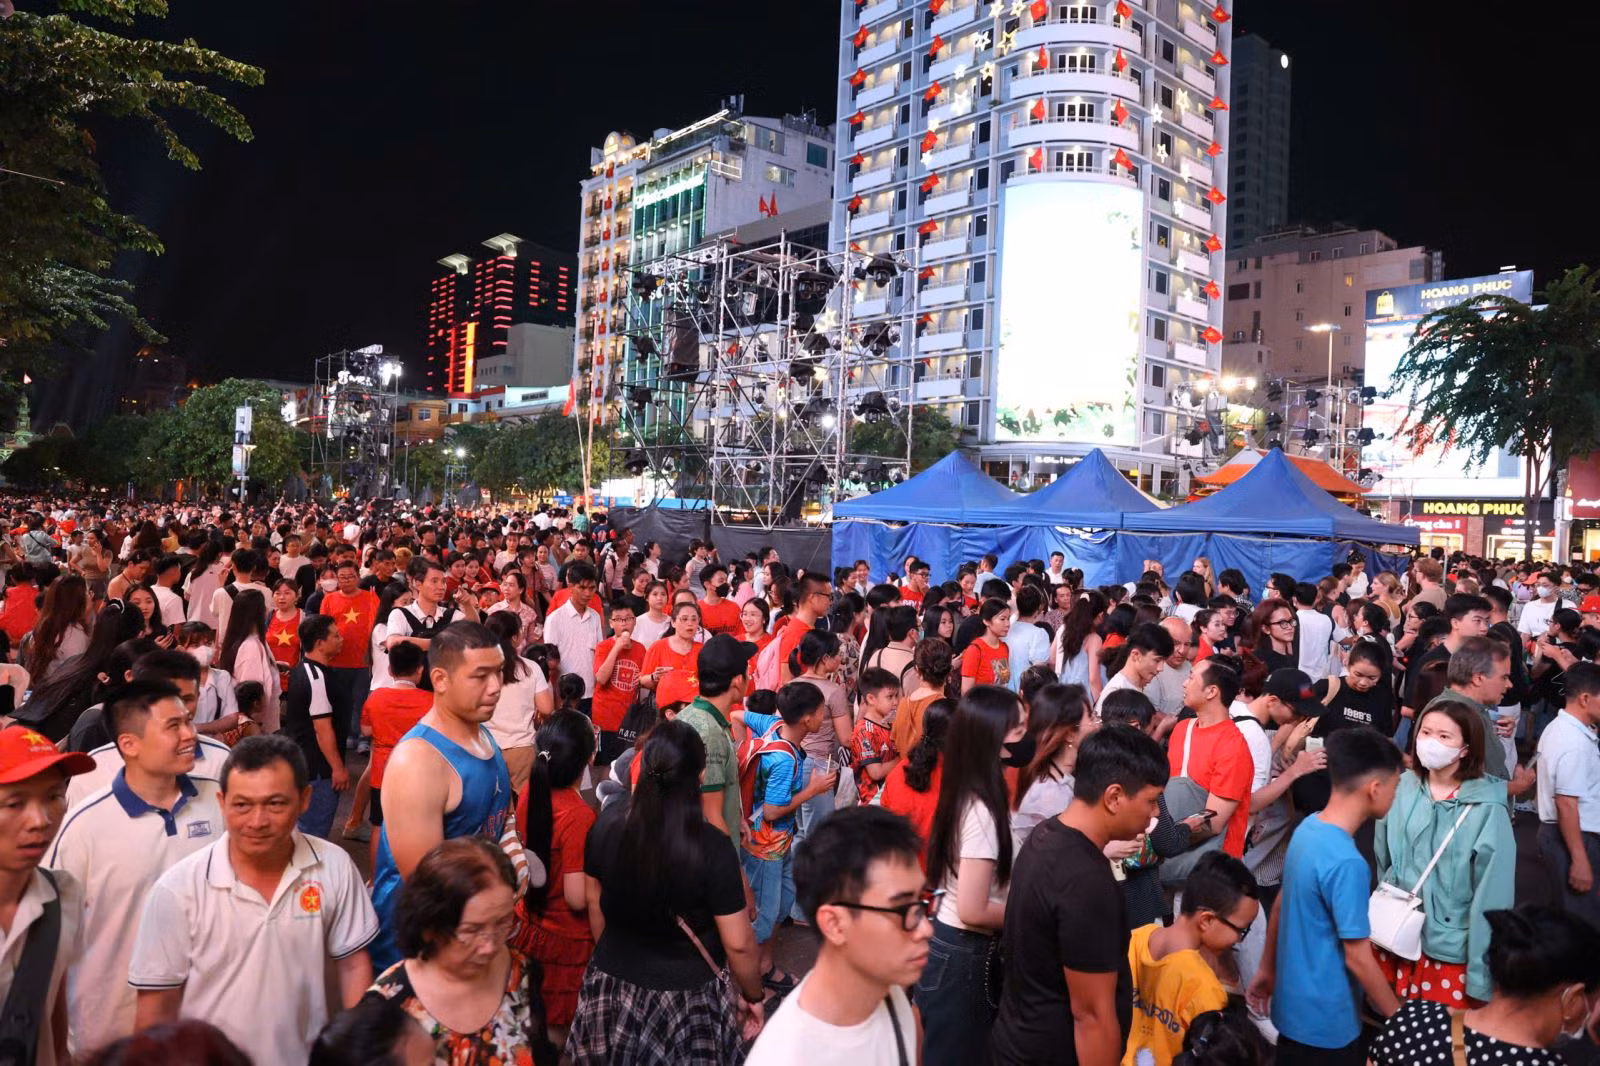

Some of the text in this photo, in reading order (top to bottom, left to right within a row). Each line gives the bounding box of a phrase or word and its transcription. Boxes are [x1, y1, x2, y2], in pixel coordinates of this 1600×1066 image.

[1421, 280, 1512, 299] HOANG PHUC
[1423, 503, 1525, 515] HOANG PHUC
